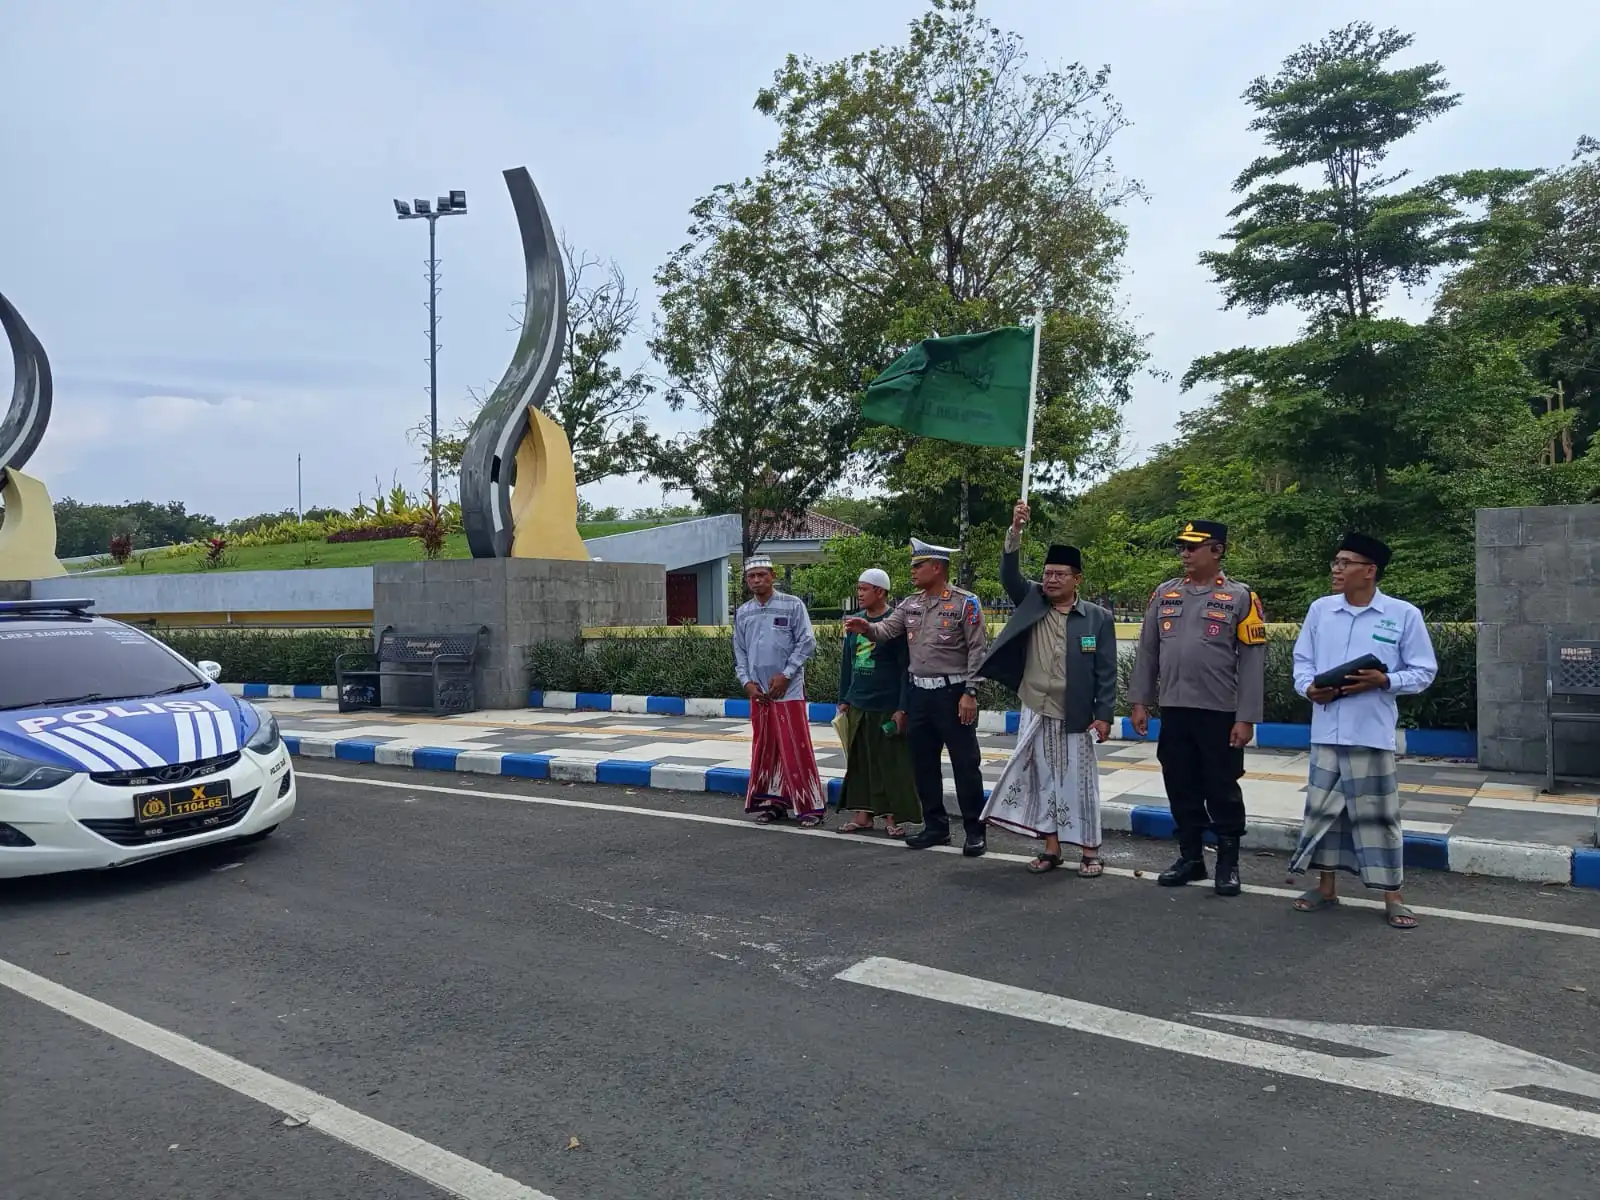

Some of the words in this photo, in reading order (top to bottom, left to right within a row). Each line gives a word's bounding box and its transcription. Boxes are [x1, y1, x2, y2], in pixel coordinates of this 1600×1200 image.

[1206, 601, 1234, 612] POLRI
[16, 700, 222, 733] POLISI
[191, 785, 206, 801] X
[177, 798, 222, 813] 1104-65
